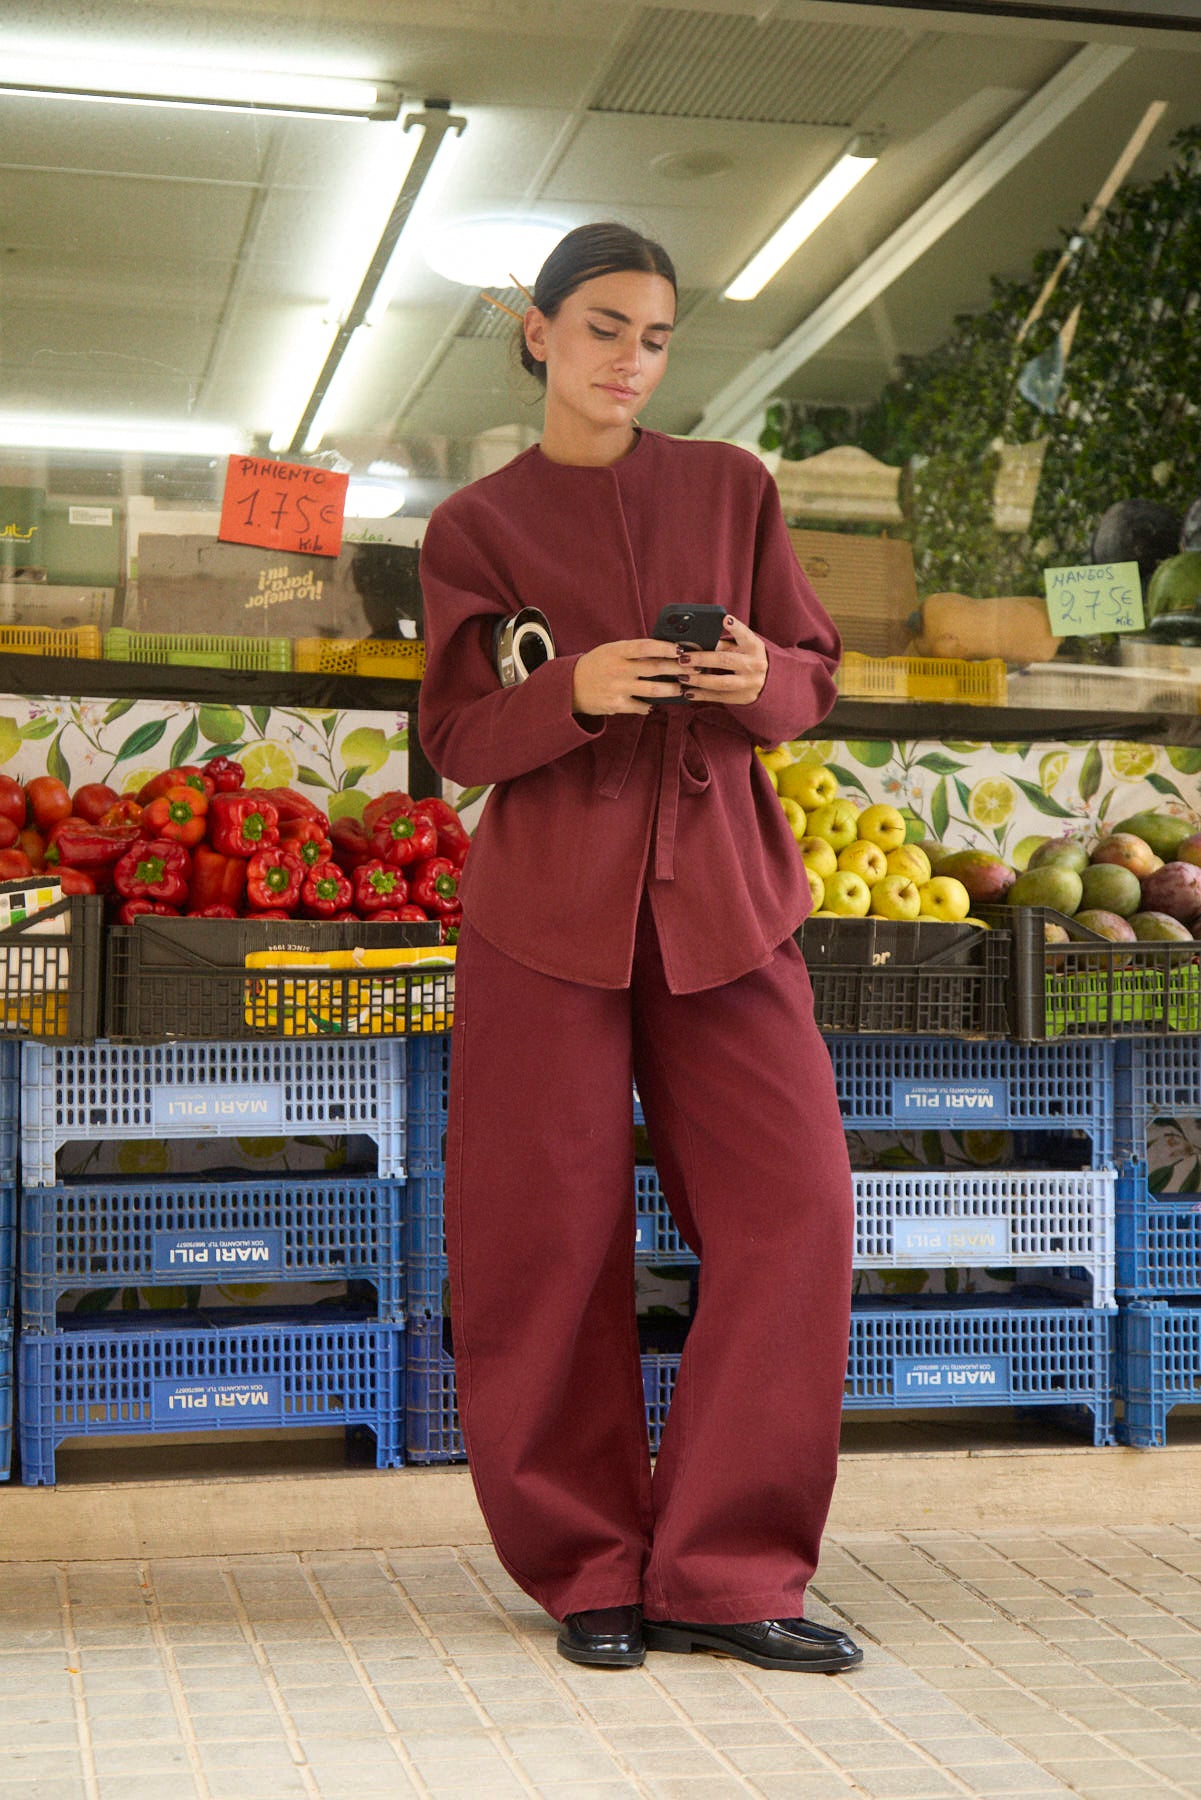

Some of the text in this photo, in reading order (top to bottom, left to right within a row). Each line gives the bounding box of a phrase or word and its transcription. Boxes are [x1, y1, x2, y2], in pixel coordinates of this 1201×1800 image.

[239, 457, 326, 484] PIMIENTO
[271, 570, 314, 592] para
[244, 588, 295, 609] mejor
[168, 1100, 268, 1115] MARI PILI
[905, 1094, 994, 1107] MARI PILI
[906, 1233, 995, 1248] MARI PILI
[169, 1247, 269, 1263] MARI PILI
[906, 1371, 996, 1385] MARI PILI
[168, 1391, 269, 1409] MARI PILI
